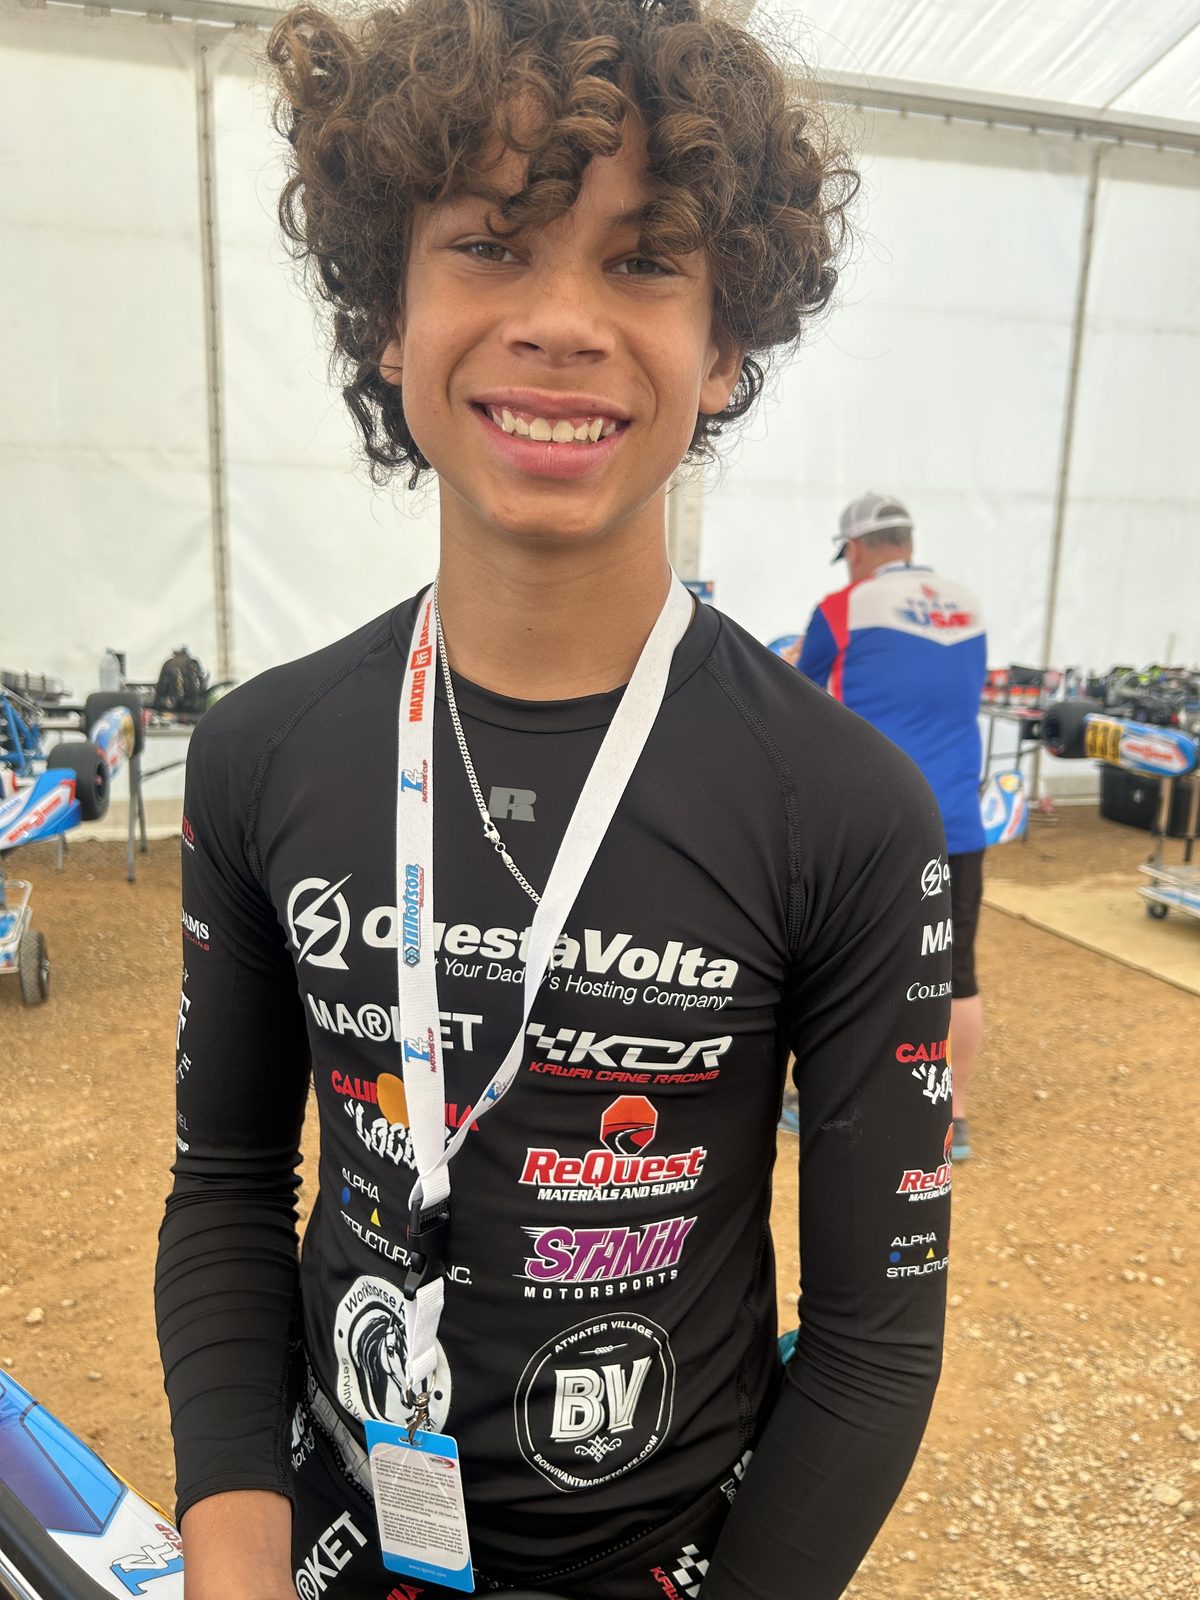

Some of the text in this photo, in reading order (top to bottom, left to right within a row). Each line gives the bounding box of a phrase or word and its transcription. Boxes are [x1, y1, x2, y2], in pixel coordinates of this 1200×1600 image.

[409, 669, 426, 723] MAXXIS
[402, 864, 419, 947] Tillotson
[362, 905, 739, 989] QesaVolta
[444, 958, 482, 979] Your
[486, 962, 560, 990] Dad's
[565, 975, 637, 1004] Hosting
[427, 1026, 435, 1042] CUP
[567, 1031, 733, 1070] KCR
[528, 1061, 720, 1084] KAWAI CANE RACING
[341, 1167, 381, 1203] ALPHA
[518, 1146, 707, 1188] ReQuest
[537, 1178, 698, 1202] MATERIALS AND SUPPLY
[340, 1210, 473, 1285] STRUCTUR NC.
[890, 1231, 937, 1247] ALPHA
[344, 1281, 397, 1314] Workhorse
[524, 1269, 678, 1300] MOTORSPORTS
[554, 1320, 653, 1354] ATWATER VILLAGE
[341, 1357, 354, 1410] Serving
[550, 1356, 653, 1443] BV
